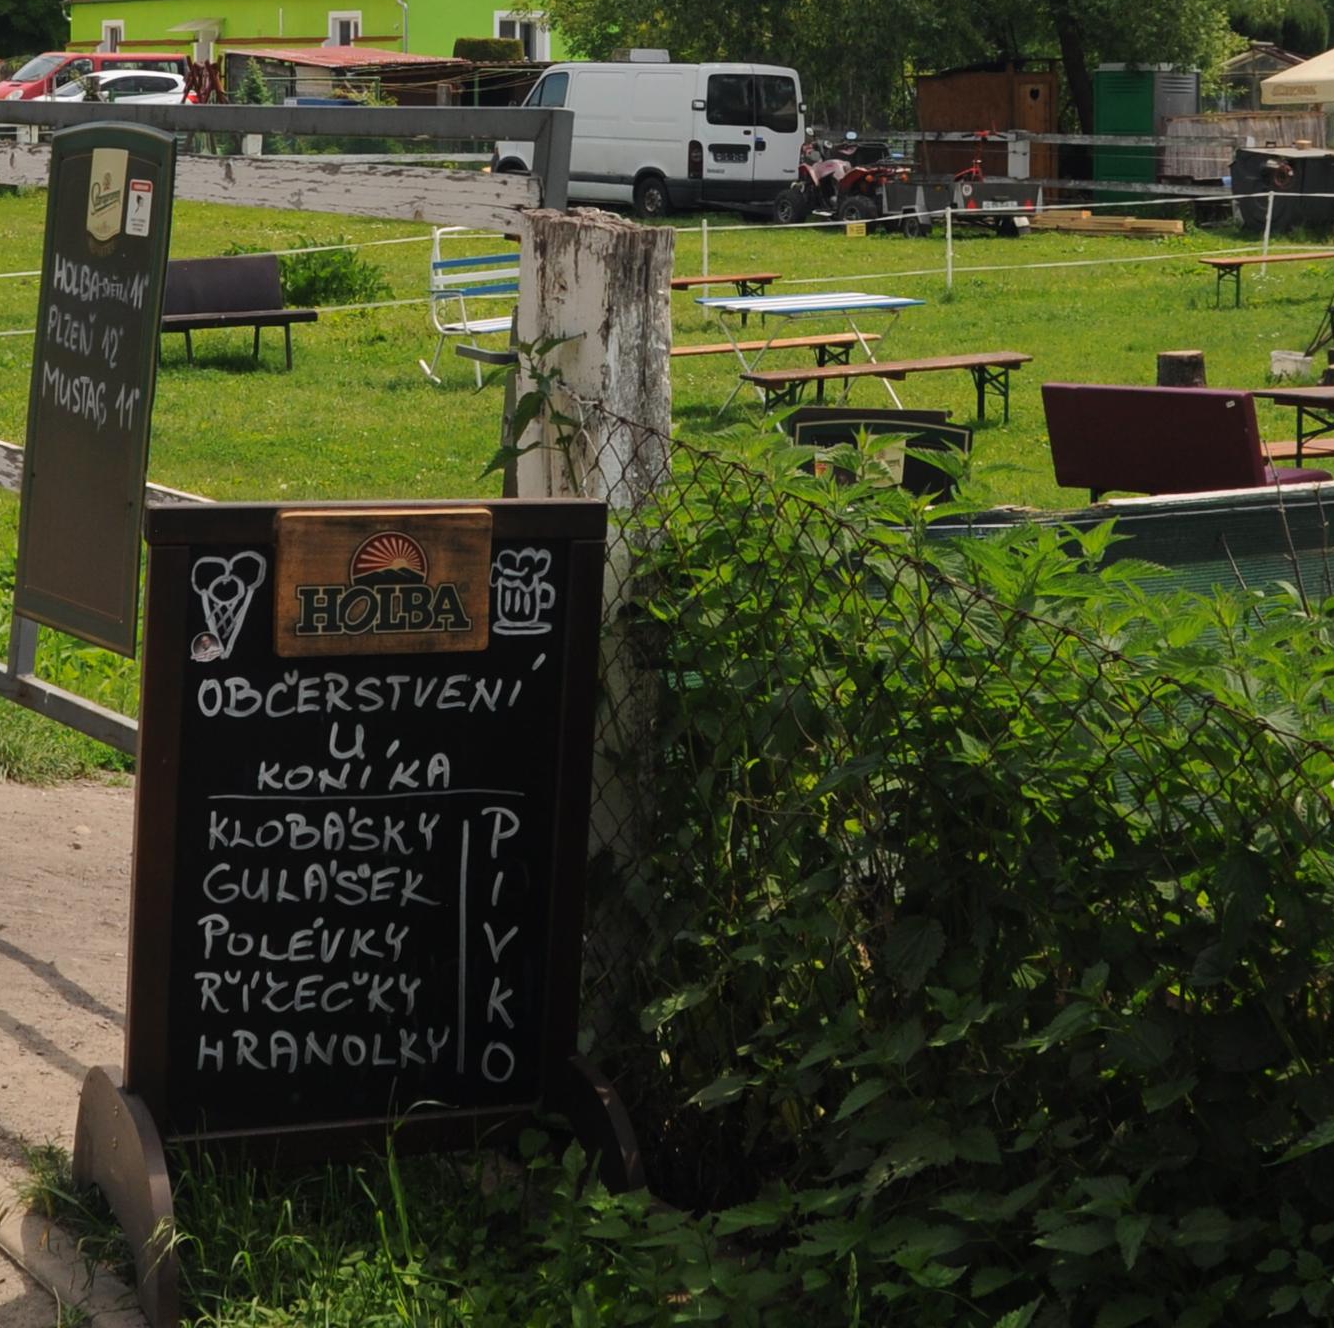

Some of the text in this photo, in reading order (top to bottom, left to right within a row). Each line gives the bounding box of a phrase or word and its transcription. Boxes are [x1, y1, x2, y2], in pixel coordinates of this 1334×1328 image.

[47, 304, 97, 357] PLZEŇ
[294, 583, 473, 636] HOLBA
[197, 653, 546, 718] OBČERSTVENÍ
[257, 738, 450, 791] KONÍKA
[328, 723, 364, 760] U
[209, 808, 440, 855] KLOBÁSKY
[203, 861, 439, 908] GULÁŠEK
[197, 915, 410, 962] POLÉVKY
[197, 1025, 450, 1074] HRANOLKY
